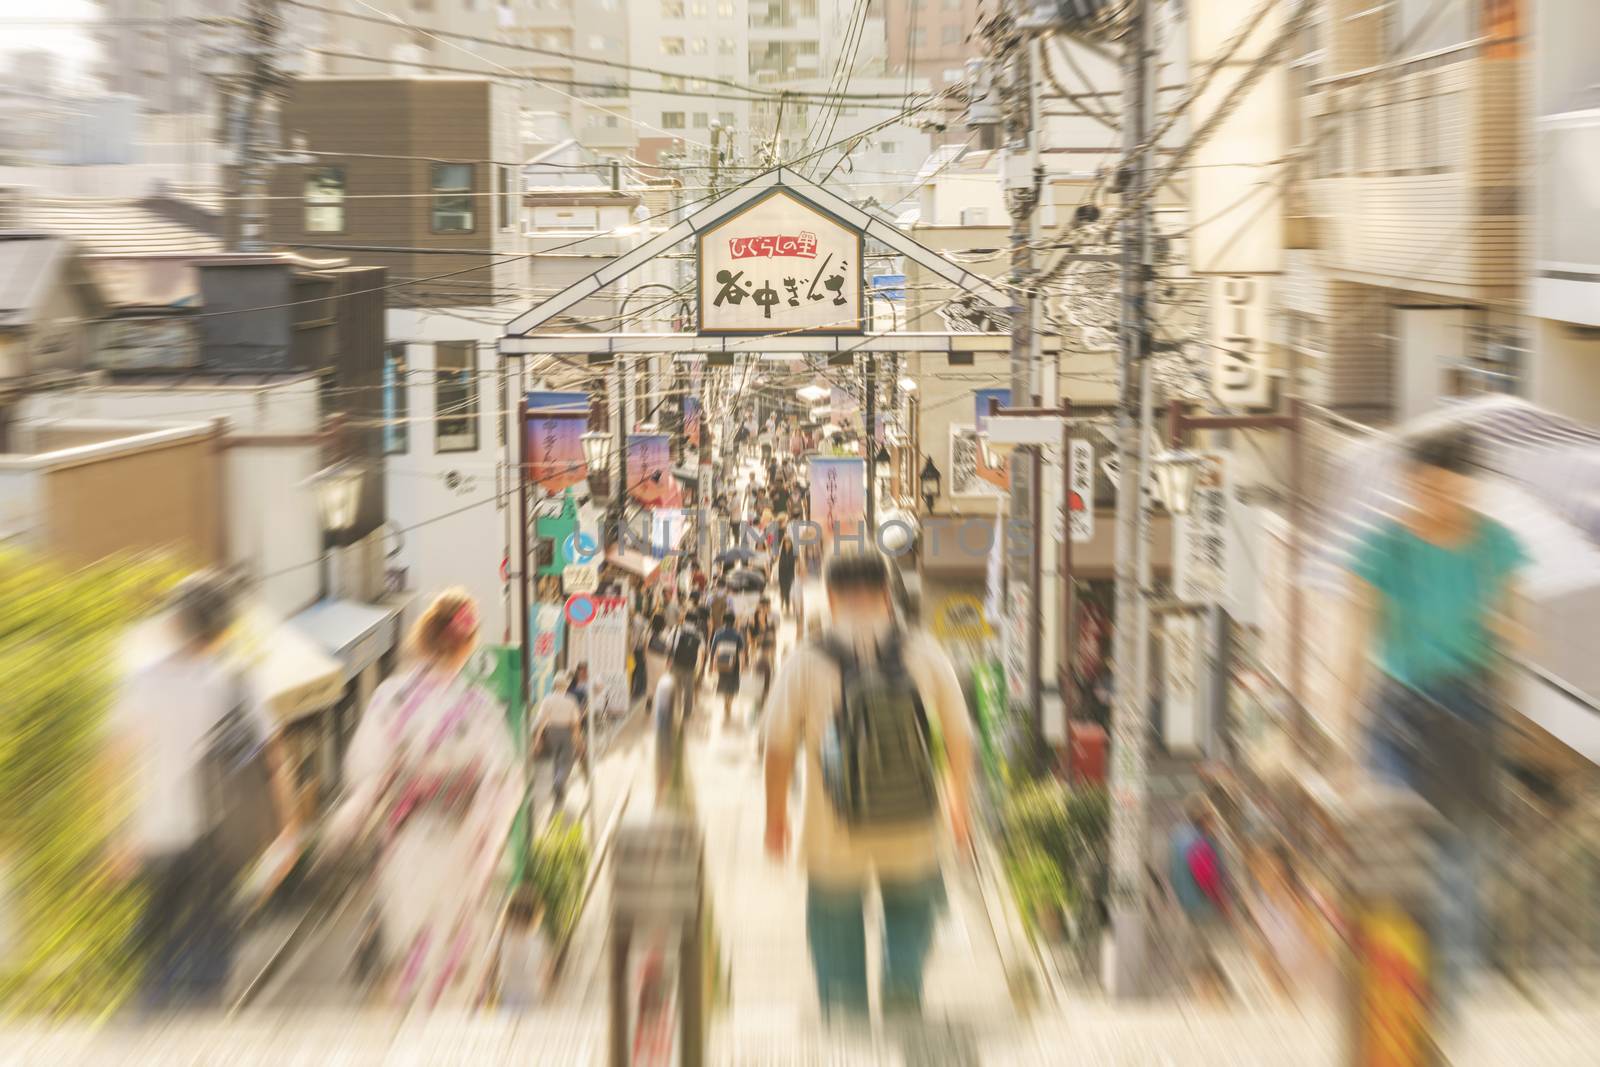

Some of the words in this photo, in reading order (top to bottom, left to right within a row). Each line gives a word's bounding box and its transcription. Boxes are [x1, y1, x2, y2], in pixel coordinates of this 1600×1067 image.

[730, 231, 817, 259] ひぐらしの里
[713, 252, 848, 319] 谷中ぎんざ
